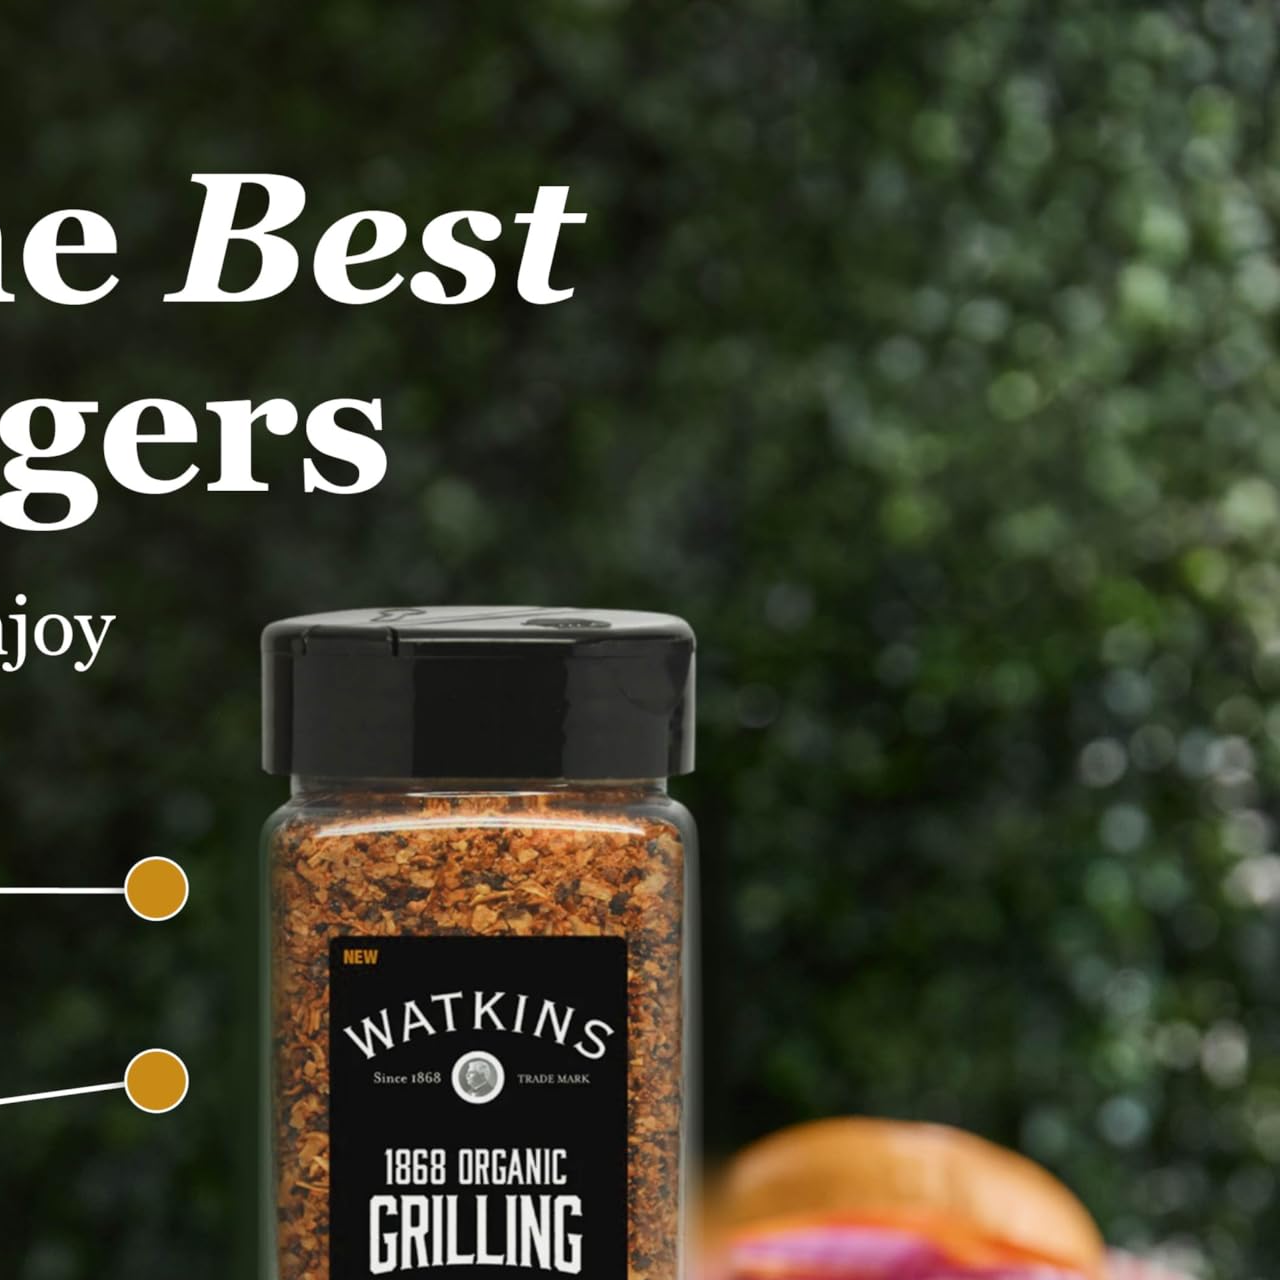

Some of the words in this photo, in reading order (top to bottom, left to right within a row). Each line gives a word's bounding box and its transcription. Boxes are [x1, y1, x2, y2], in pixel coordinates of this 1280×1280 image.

[343, 949, 379, 965] NEW
[343, 990, 615, 1061] WATKINS
[373, 1071, 408, 1084] Since
[411, 1071, 442, 1084] 1868
[517, 1073, 555, 1084] TRADE
[557, 1073, 590, 1084] MARK
[385, 1148, 446, 1185] 1868
[458, 1147, 567, 1185] ORGANIC
[369, 1194, 583, 1275] GRILLING
